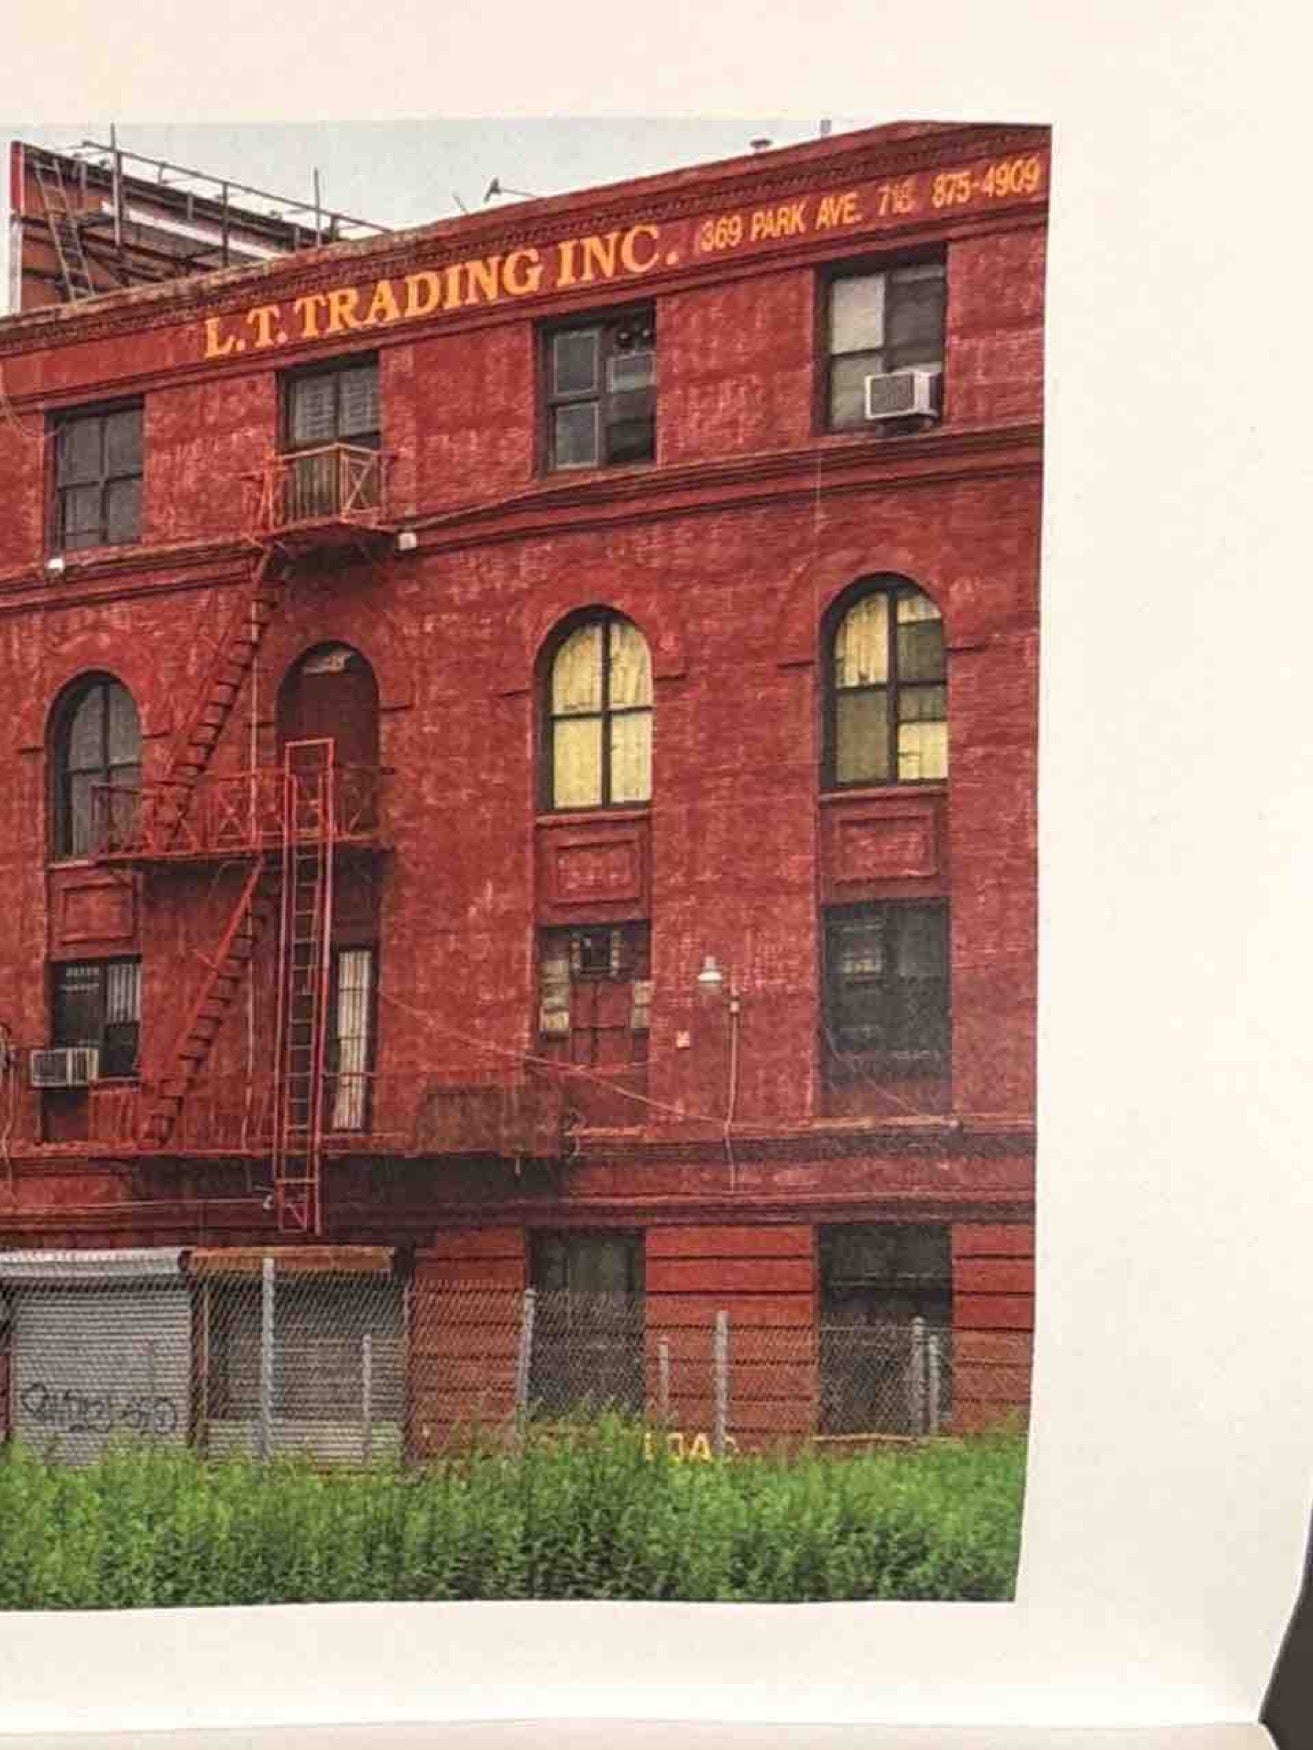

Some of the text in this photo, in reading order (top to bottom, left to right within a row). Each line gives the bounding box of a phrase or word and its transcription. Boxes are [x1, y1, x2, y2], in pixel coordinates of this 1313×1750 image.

[750, 202, 806, 241] PARK
[204, 224, 678, 358] L.T. TRADING INC.
